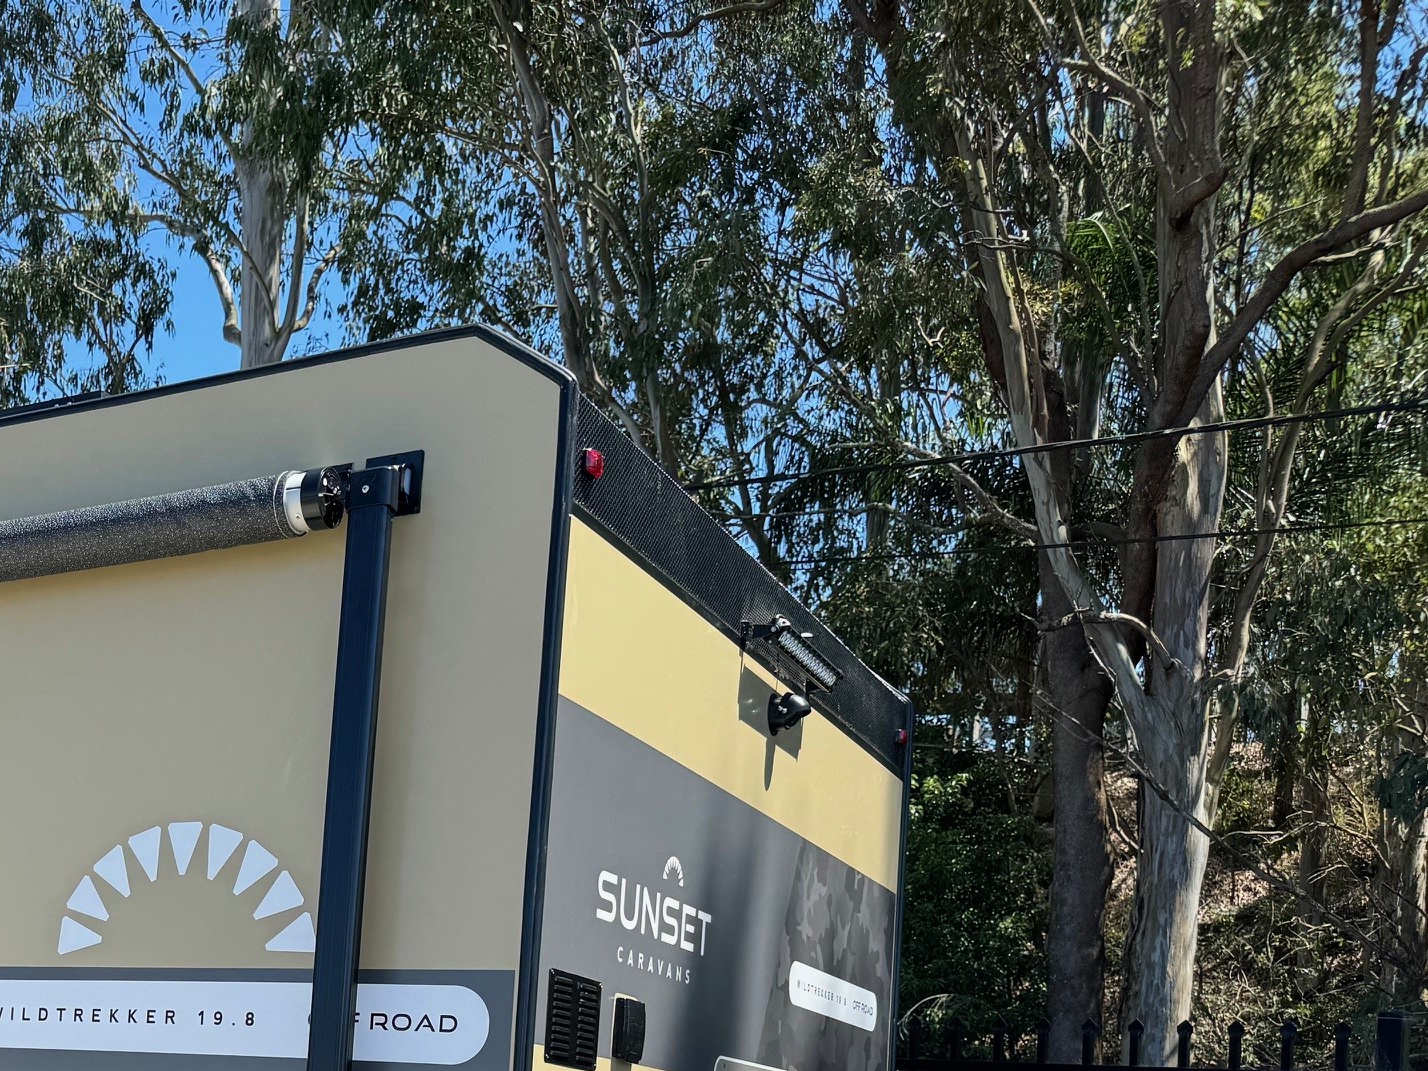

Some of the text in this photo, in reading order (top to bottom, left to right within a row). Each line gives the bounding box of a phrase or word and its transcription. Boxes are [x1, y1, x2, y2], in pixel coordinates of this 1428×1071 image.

[596, 870, 712, 956] SUNSET
[617, 946, 691, 984] CARAVANS
[197, 1010, 255, 1027] 19.8
[369, 1012, 459, 1034] ROAD
